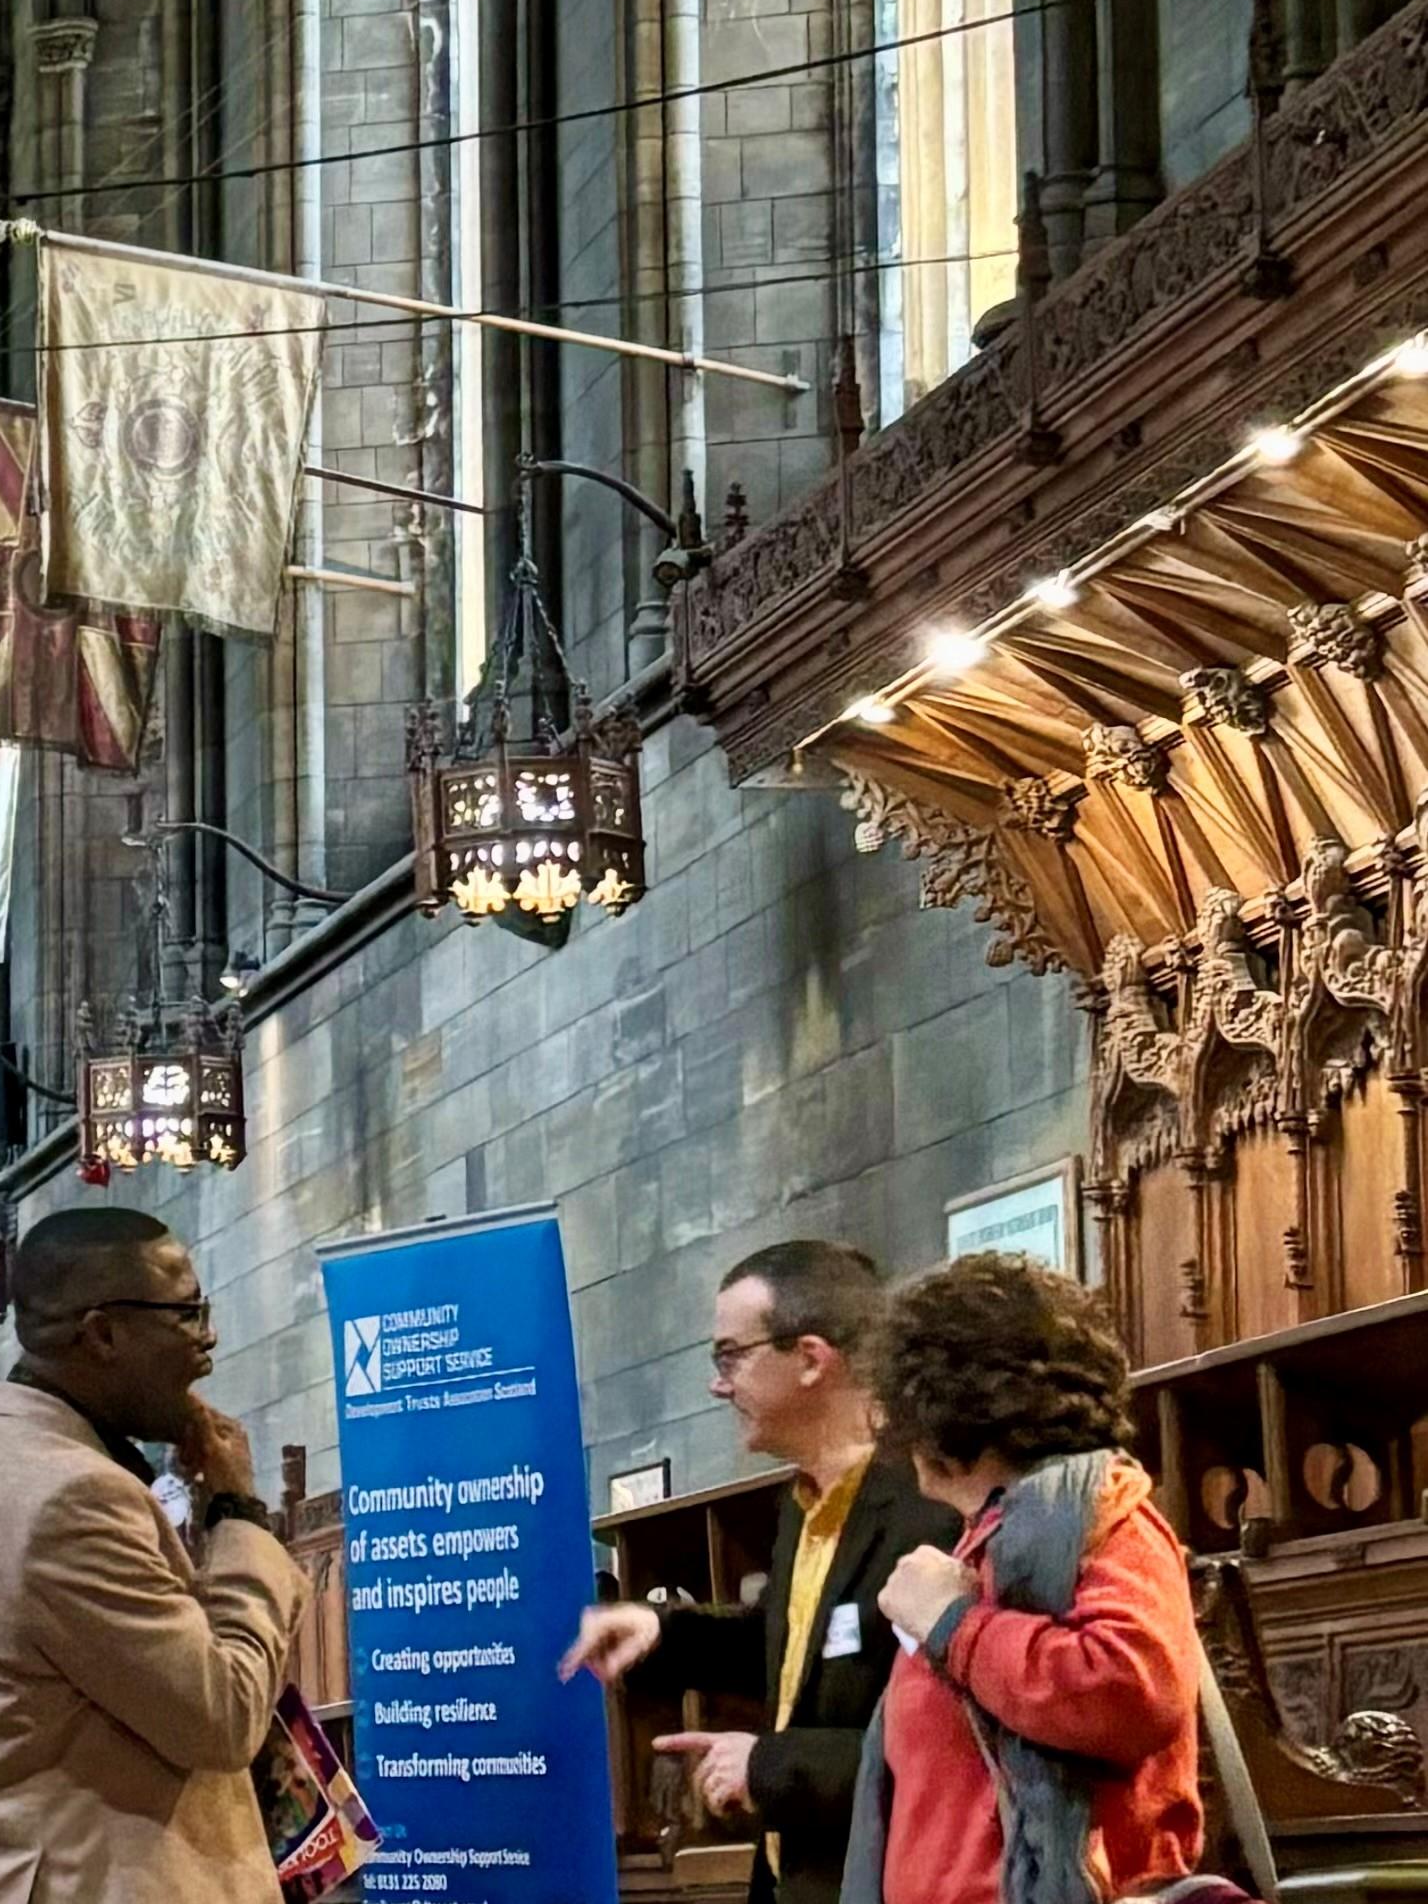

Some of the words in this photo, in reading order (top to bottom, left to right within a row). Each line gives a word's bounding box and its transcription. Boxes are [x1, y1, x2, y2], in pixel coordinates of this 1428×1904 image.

[382, 1304, 459, 1332] COMMUNITY
[382, 1328, 460, 1356] OWNERSHIP
[383, 1356, 442, 1381] SUPPORT
[445, 1347, 493, 1372] SERVICE
[405, 1394, 440, 1411] Trusts
[349, 1475, 453, 1516] Community
[458, 1464, 544, 1505] ownership
[350, 1530, 367, 1563] of
[371, 1529, 428, 1561] assets
[432, 1524, 520, 1561] empowers
[352, 1577, 383, 1611] and
[386, 1574, 462, 1614] inspires
[467, 1567, 520, 1612] people
[372, 1647, 430, 1675] Creating
[433, 1641, 515, 1673] opportunities
[375, 1700, 432, 1729] Building
[435, 1697, 497, 1722] resilience
[376, 1752, 470, 1782] Transforming
[472, 1750, 547, 1776] communities
[414, 1848, 468, 1868] Ownership
[468, 1848, 502, 1868] Support
[377, 1874, 400, 1890] 0131
[401, 1874, 420, 1890] 225
